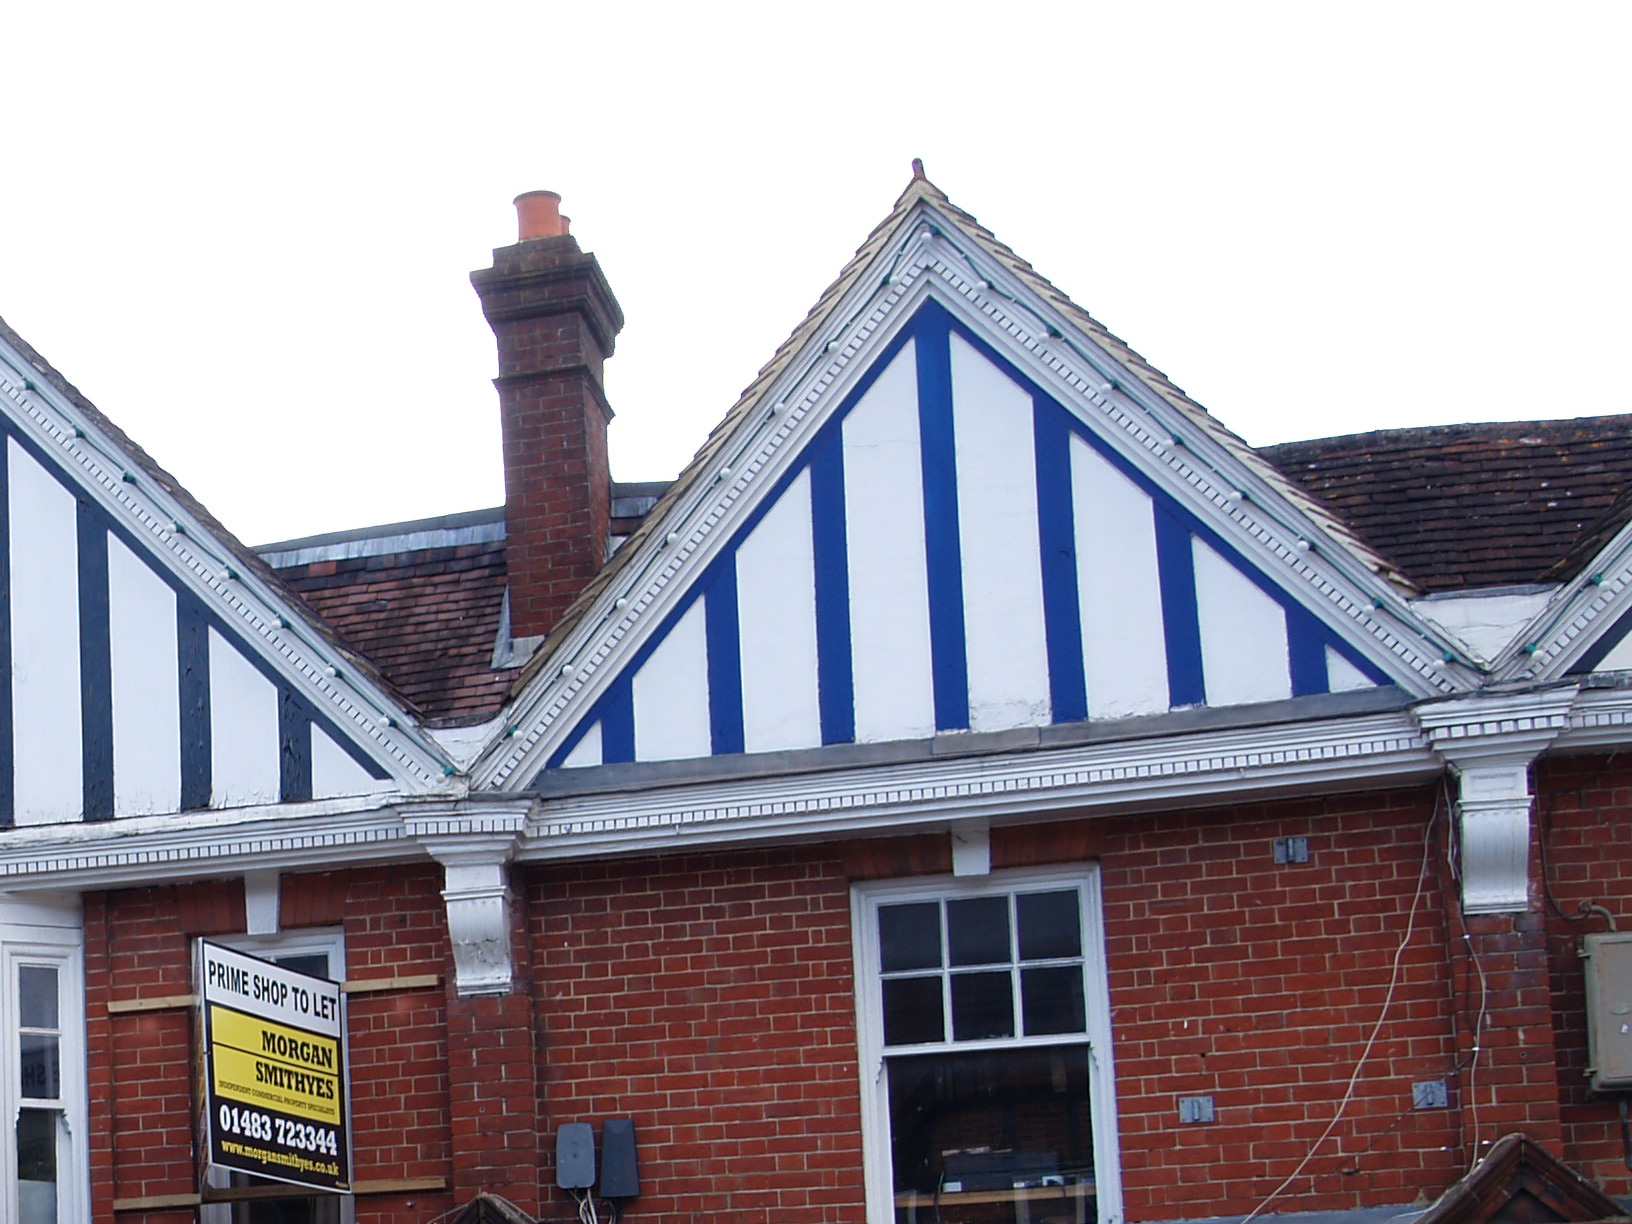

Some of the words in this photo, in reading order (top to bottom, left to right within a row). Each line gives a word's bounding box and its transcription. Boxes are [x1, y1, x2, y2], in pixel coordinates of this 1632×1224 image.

[208, 960, 249, 996] PRIME
[253, 974, 288, 1008] SHOP
[292, 986, 309, 1013] TO
[313, 992, 337, 1021] LET
[261, 1030, 333, 1069] MORGAN
[255, 1061, 334, 1100] SMITHYES
[219, 1104, 272, 1141] 01483
[275, 1118, 337, 1156] 723344
[221, 1140, 339, 1176] www.morgansmithyes.co.uk
